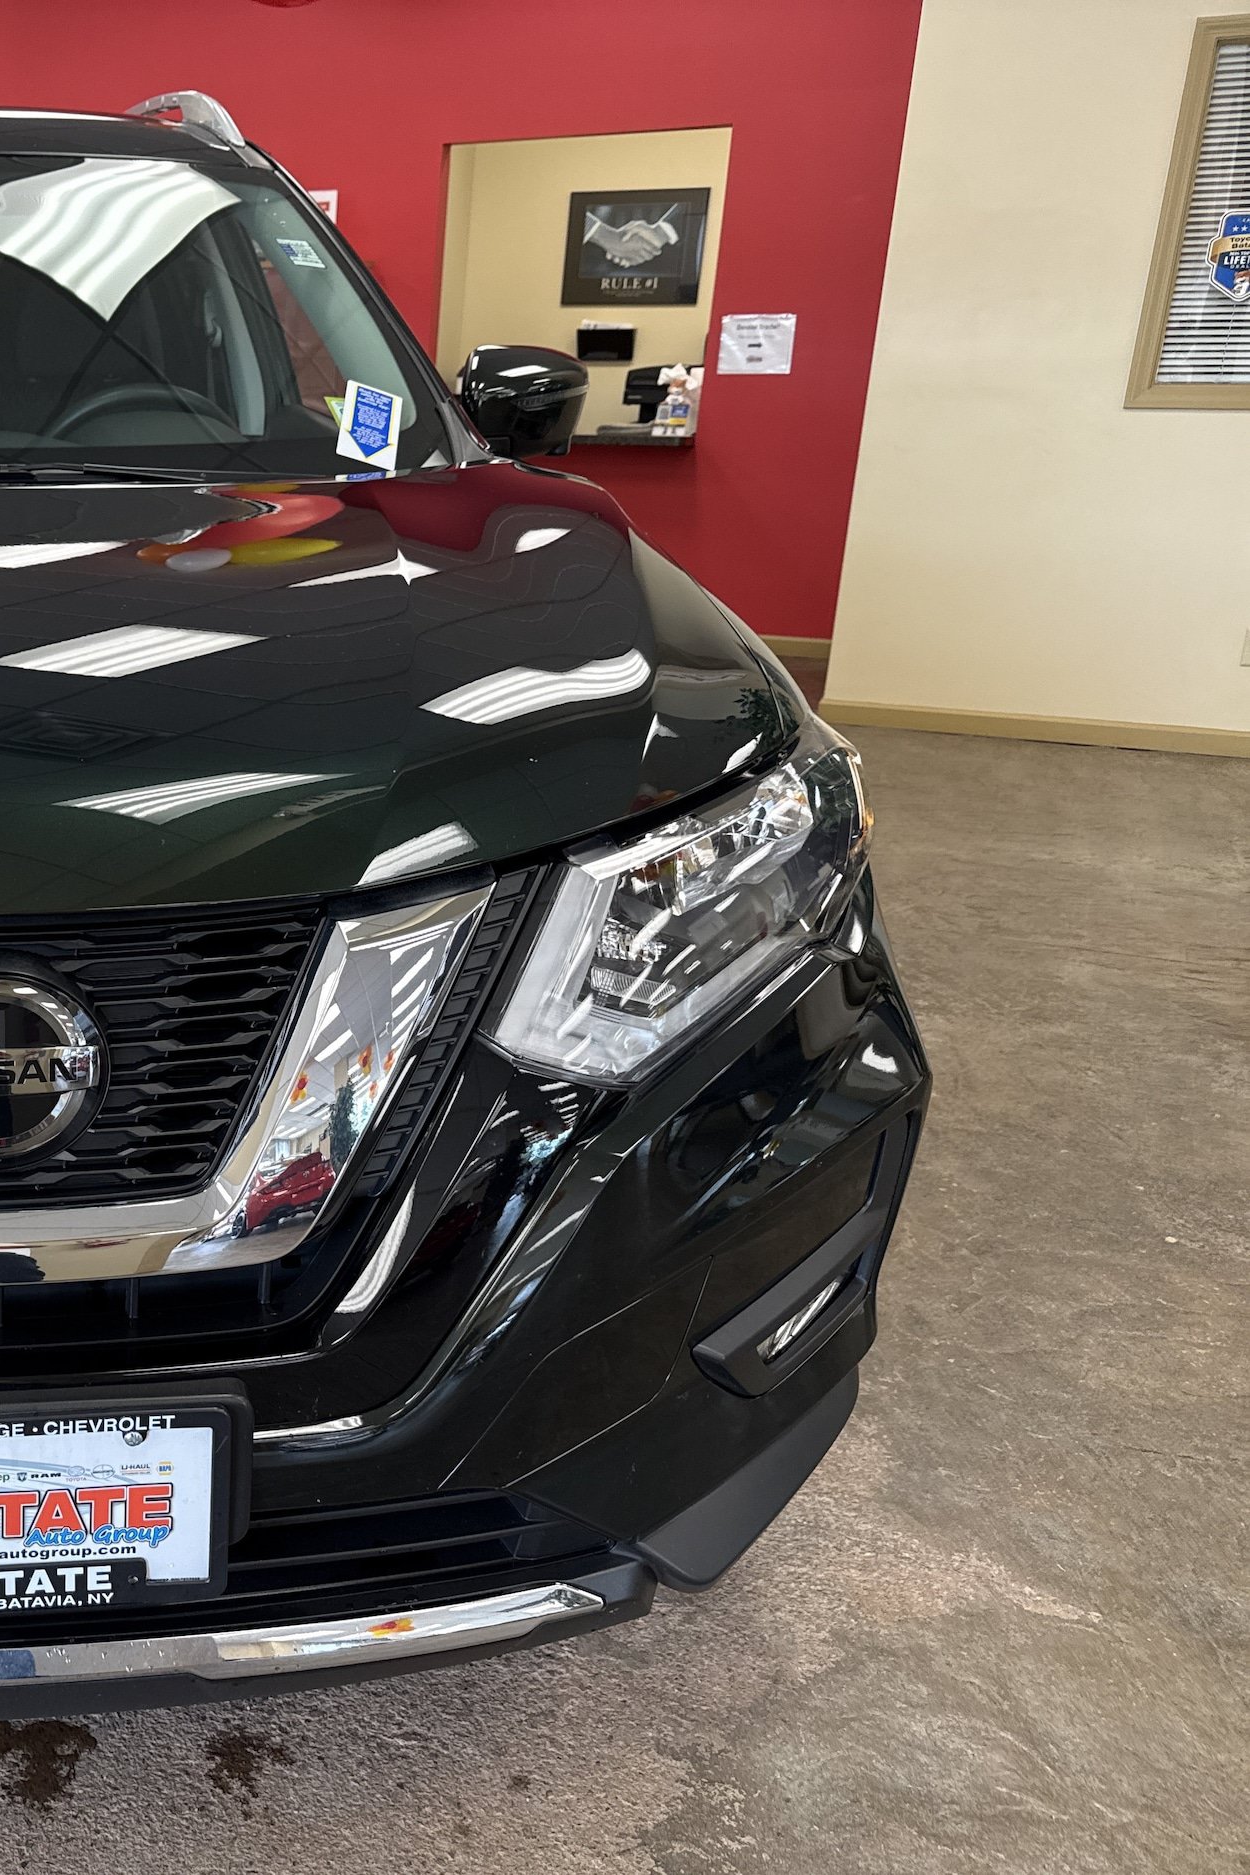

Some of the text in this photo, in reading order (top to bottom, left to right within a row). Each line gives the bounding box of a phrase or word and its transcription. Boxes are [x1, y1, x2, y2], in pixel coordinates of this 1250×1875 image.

[601, 277, 642, 290] RULE
[43, 1415, 176, 1436] CHEVROLET
[25, 1525, 170, 1548] Auto Group
[87, 1592, 114, 1605] NY
